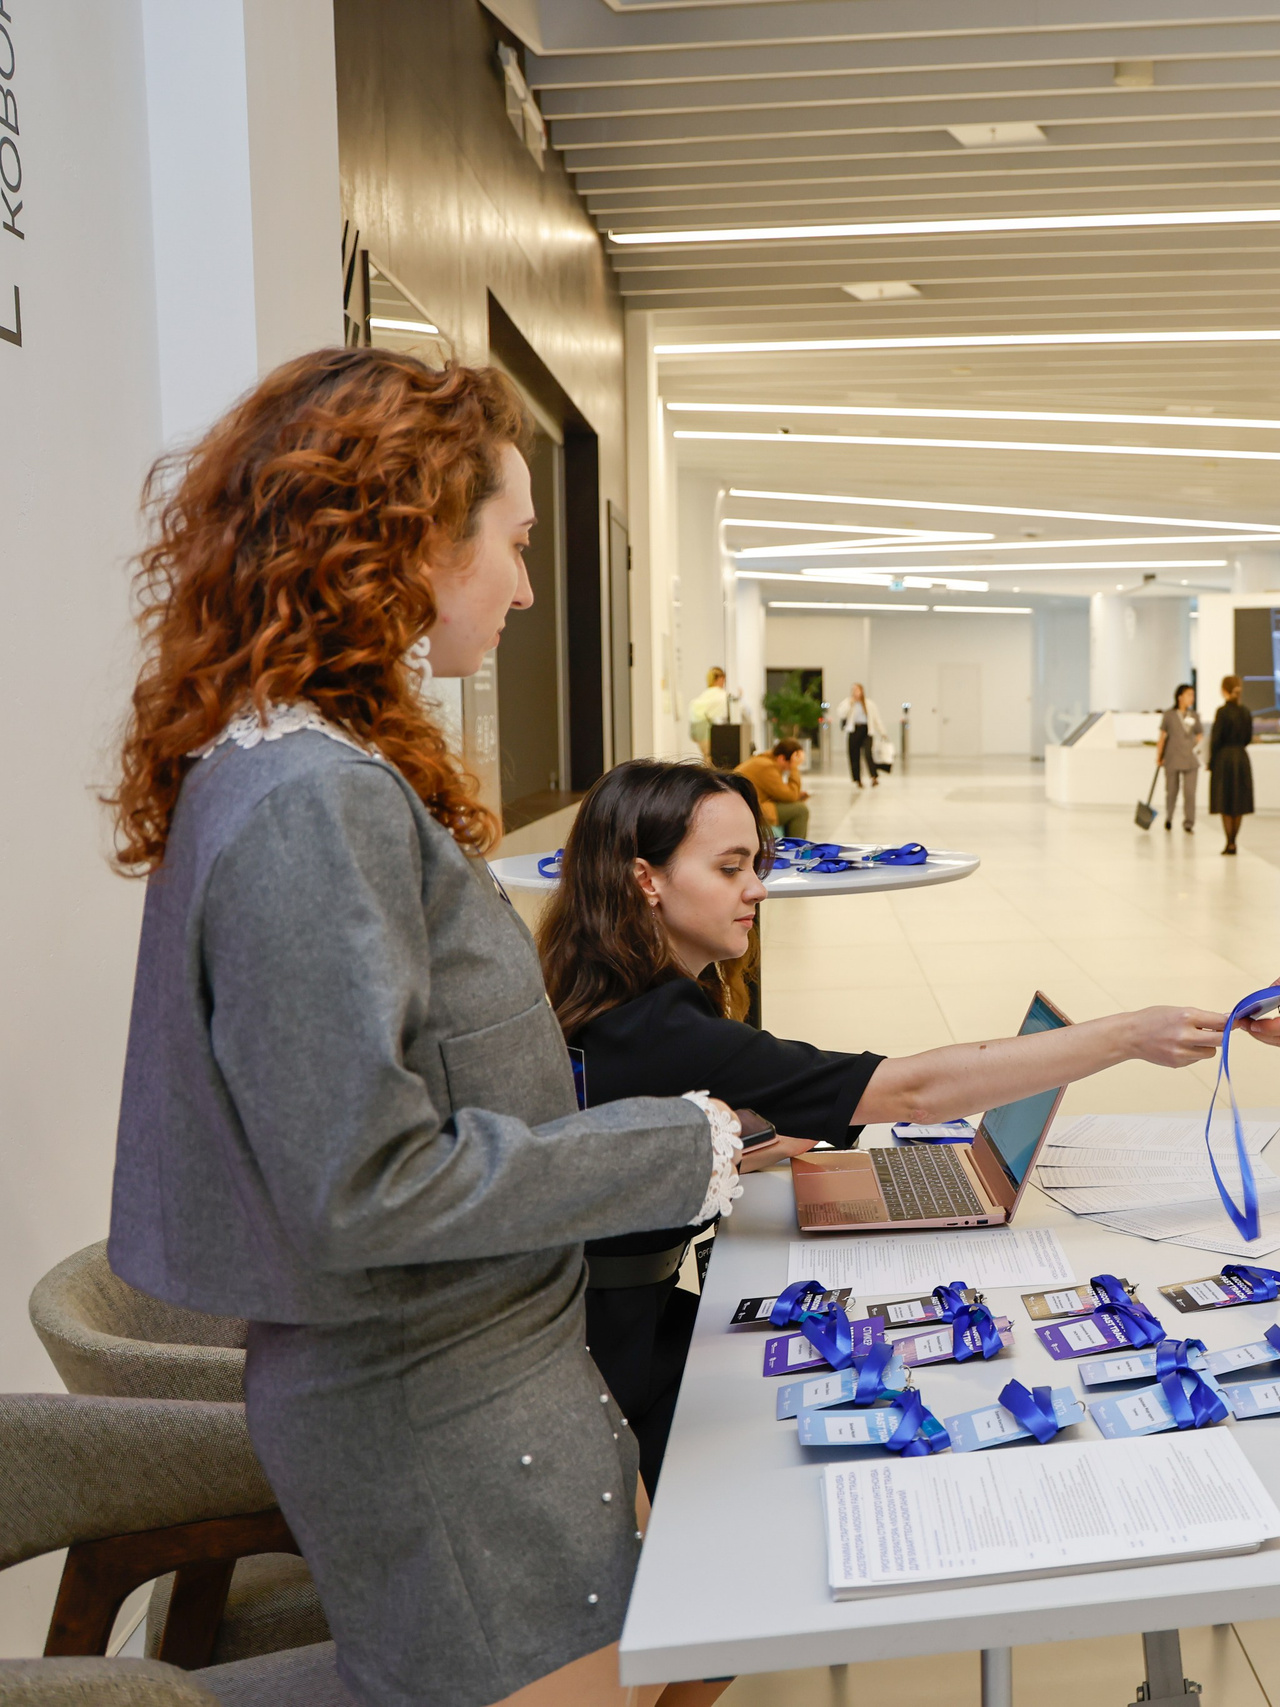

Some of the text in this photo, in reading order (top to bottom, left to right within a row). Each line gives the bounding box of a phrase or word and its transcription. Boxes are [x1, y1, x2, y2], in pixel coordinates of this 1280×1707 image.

[1230, 1276, 1254, 1295] MOSCOW
[1230, 1285, 1248, 1300] TRACK
[862, 1326, 873, 1346] СПИКЕР
[1101, 1314, 1116, 1327] FAST
[1110, 1325, 1127, 1343] TRACK
[875, 1412, 887, 1428] FAST
